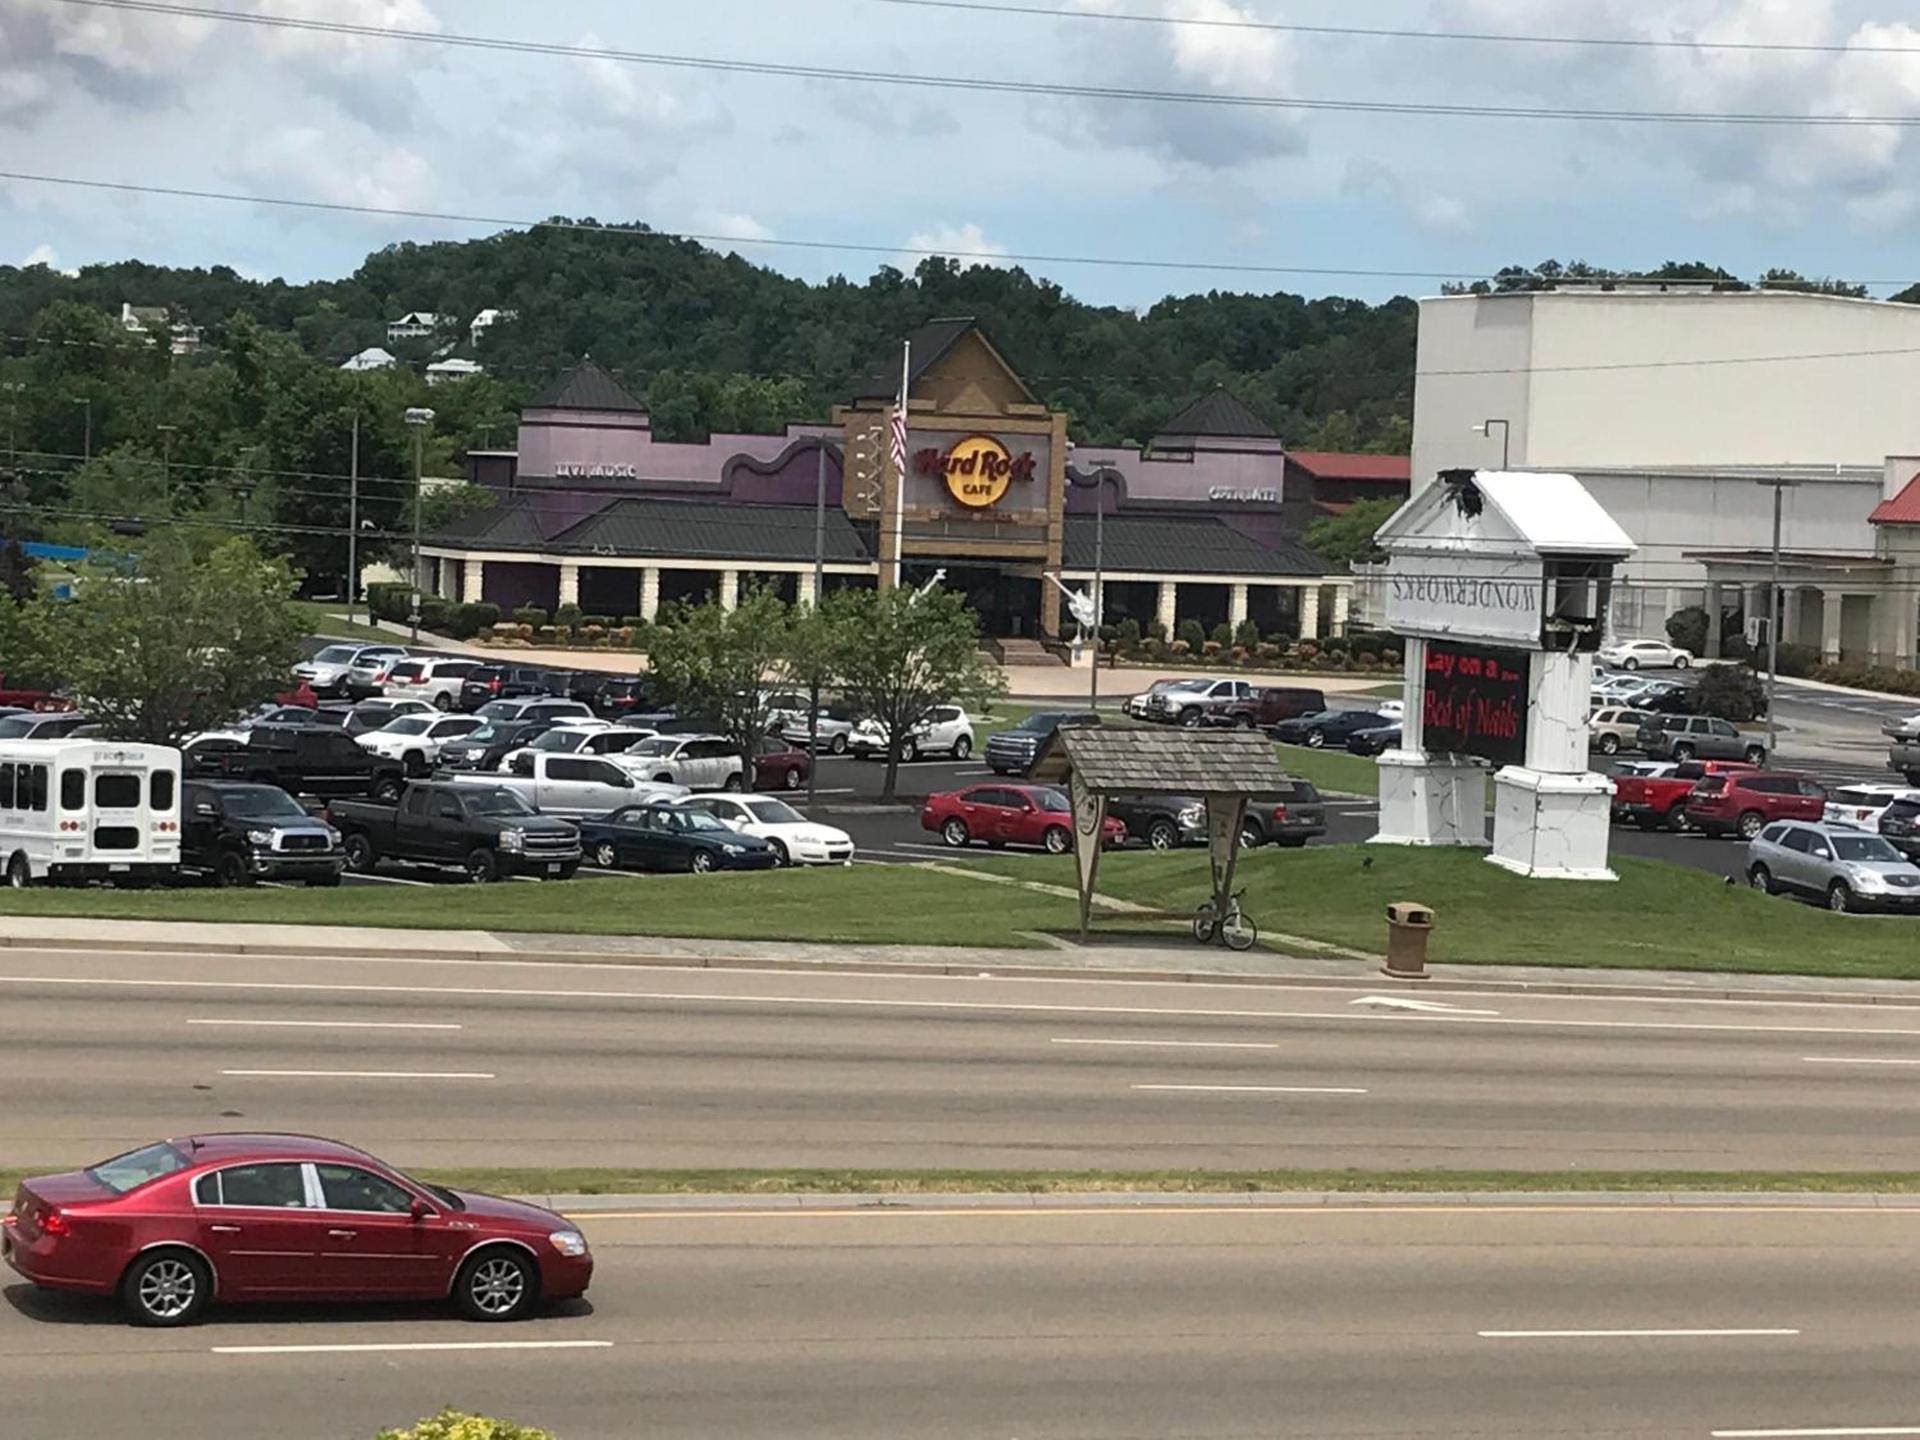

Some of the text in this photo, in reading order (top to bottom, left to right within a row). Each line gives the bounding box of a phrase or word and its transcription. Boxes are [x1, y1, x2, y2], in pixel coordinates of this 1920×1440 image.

[915, 448, 1037, 480] Hard Rock
[963, 484, 993, 497] CAFE
[1423, 653, 1452, 680] Lay
[1459, 657, 1481, 676] on
[1486, 660, 1498, 678] a
